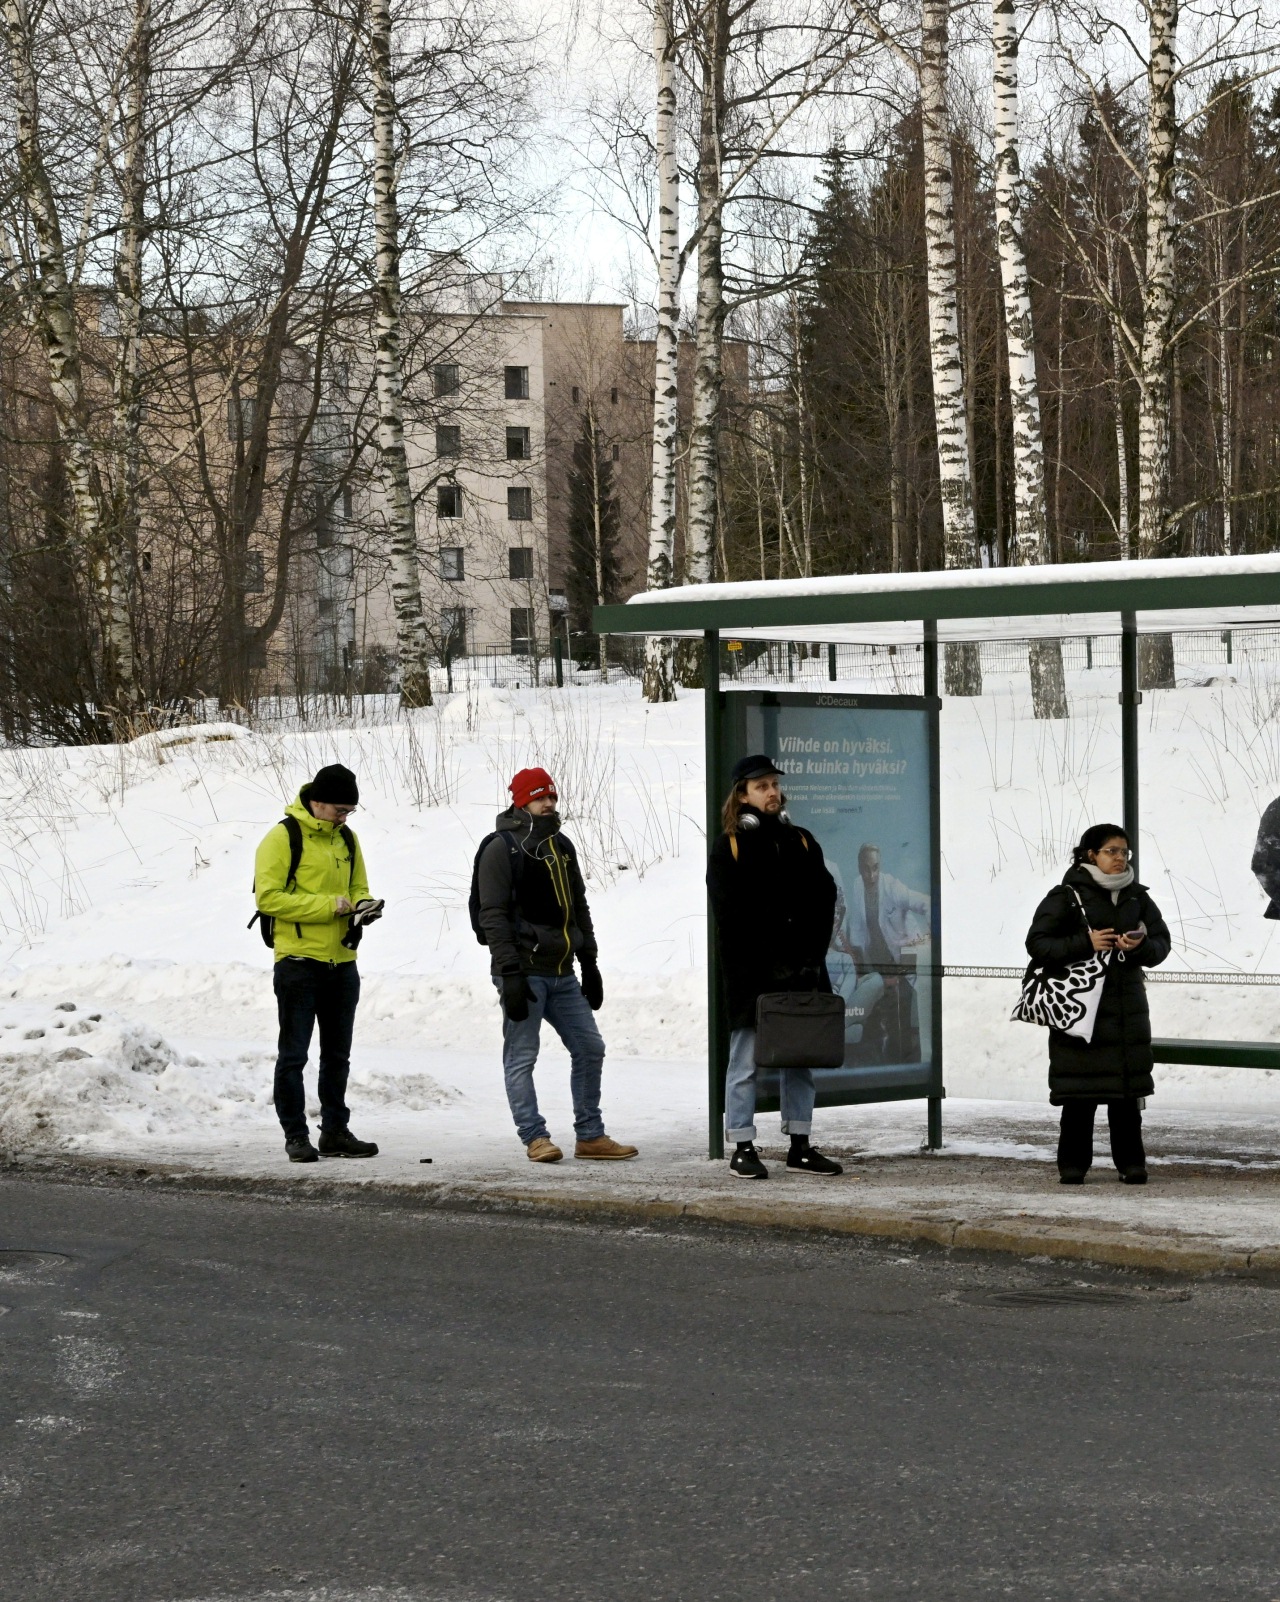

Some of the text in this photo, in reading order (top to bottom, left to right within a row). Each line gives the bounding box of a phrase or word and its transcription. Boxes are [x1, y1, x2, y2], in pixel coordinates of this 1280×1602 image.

[815, 695, 858, 706] JCDecaux
[778, 737, 894, 756] Viihde on hyväksi.
[806, 758, 849, 774] kuinka
[852, 759, 908, 778] hyväksi?
